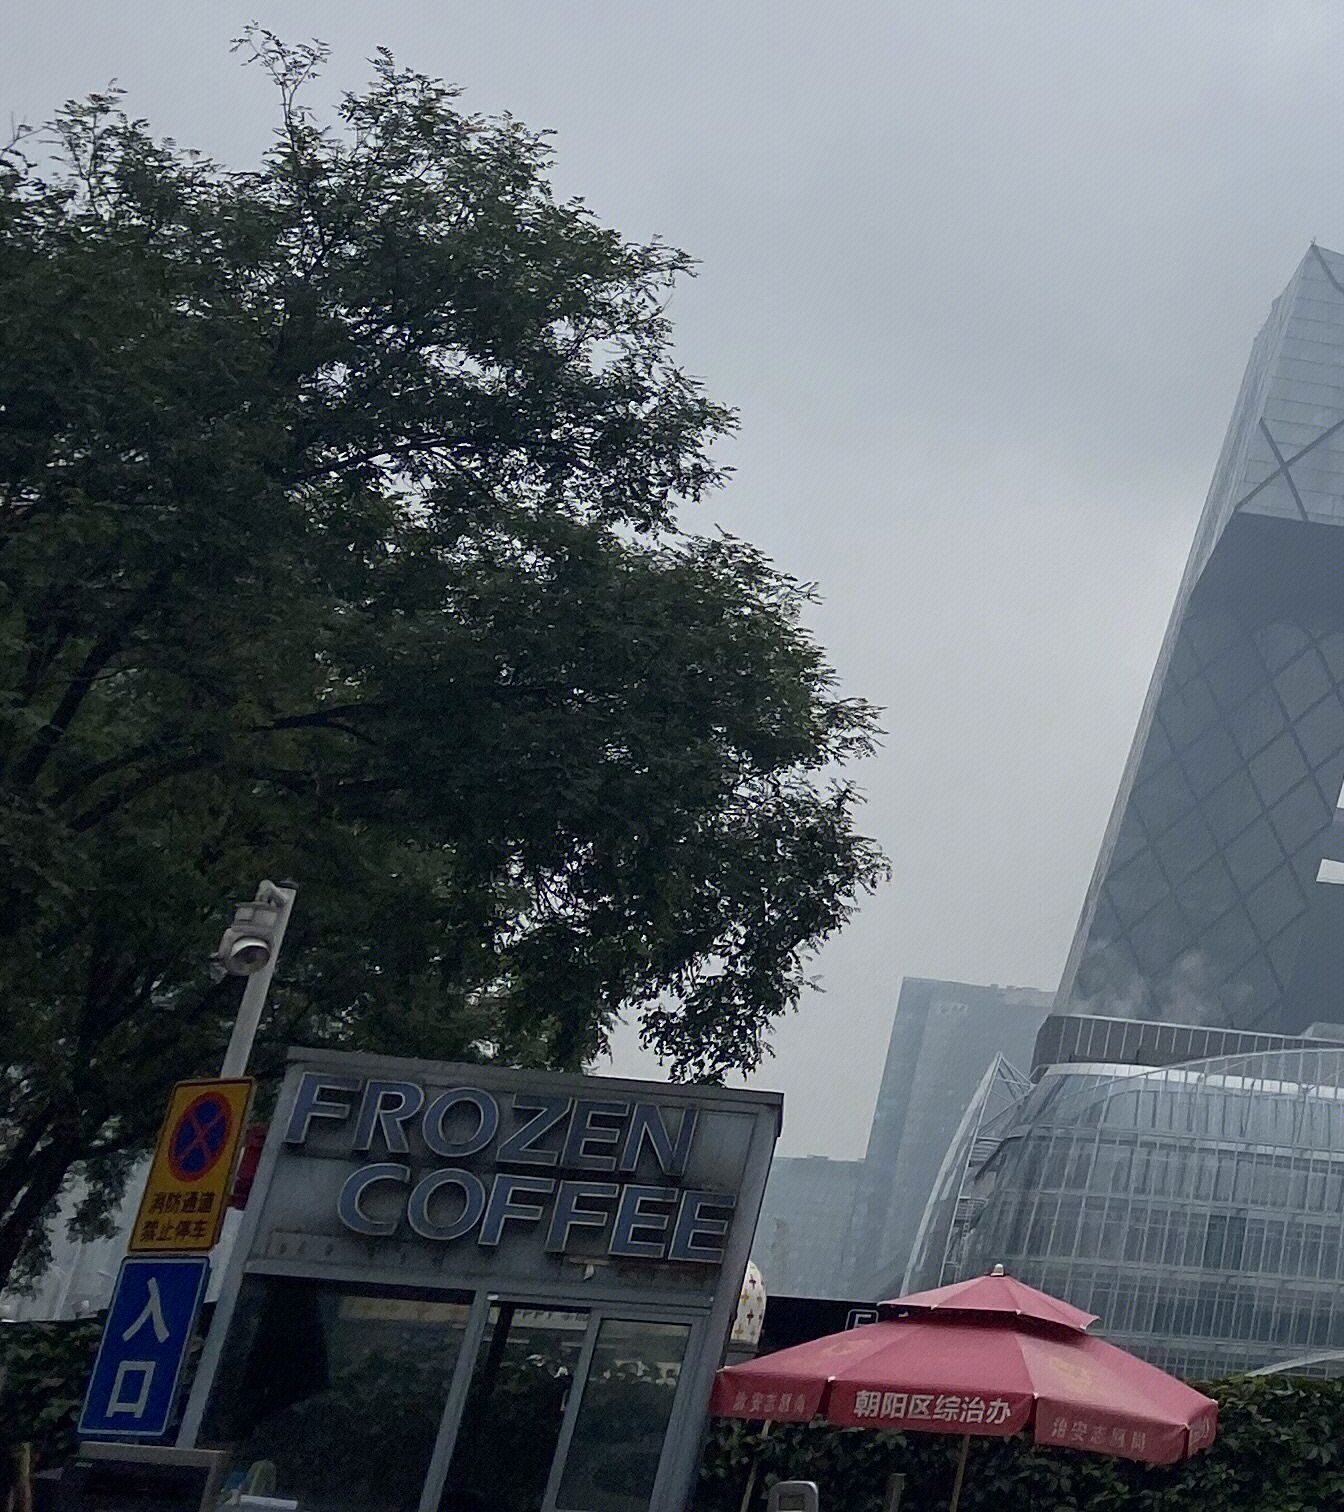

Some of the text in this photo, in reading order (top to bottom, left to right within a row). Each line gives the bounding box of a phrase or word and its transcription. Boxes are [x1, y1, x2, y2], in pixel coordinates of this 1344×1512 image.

[283, 1071, 699, 1177] FROZEN
[140, 1219, 208, 1242] 禁止停车
[148, 1191, 215, 1214] 消防通道
[336, 1163, 737, 1264] COFFEE
[105, 1276, 170, 1419] 入口
[853, 1389, 1012, 1425] 朝阳区综治办
